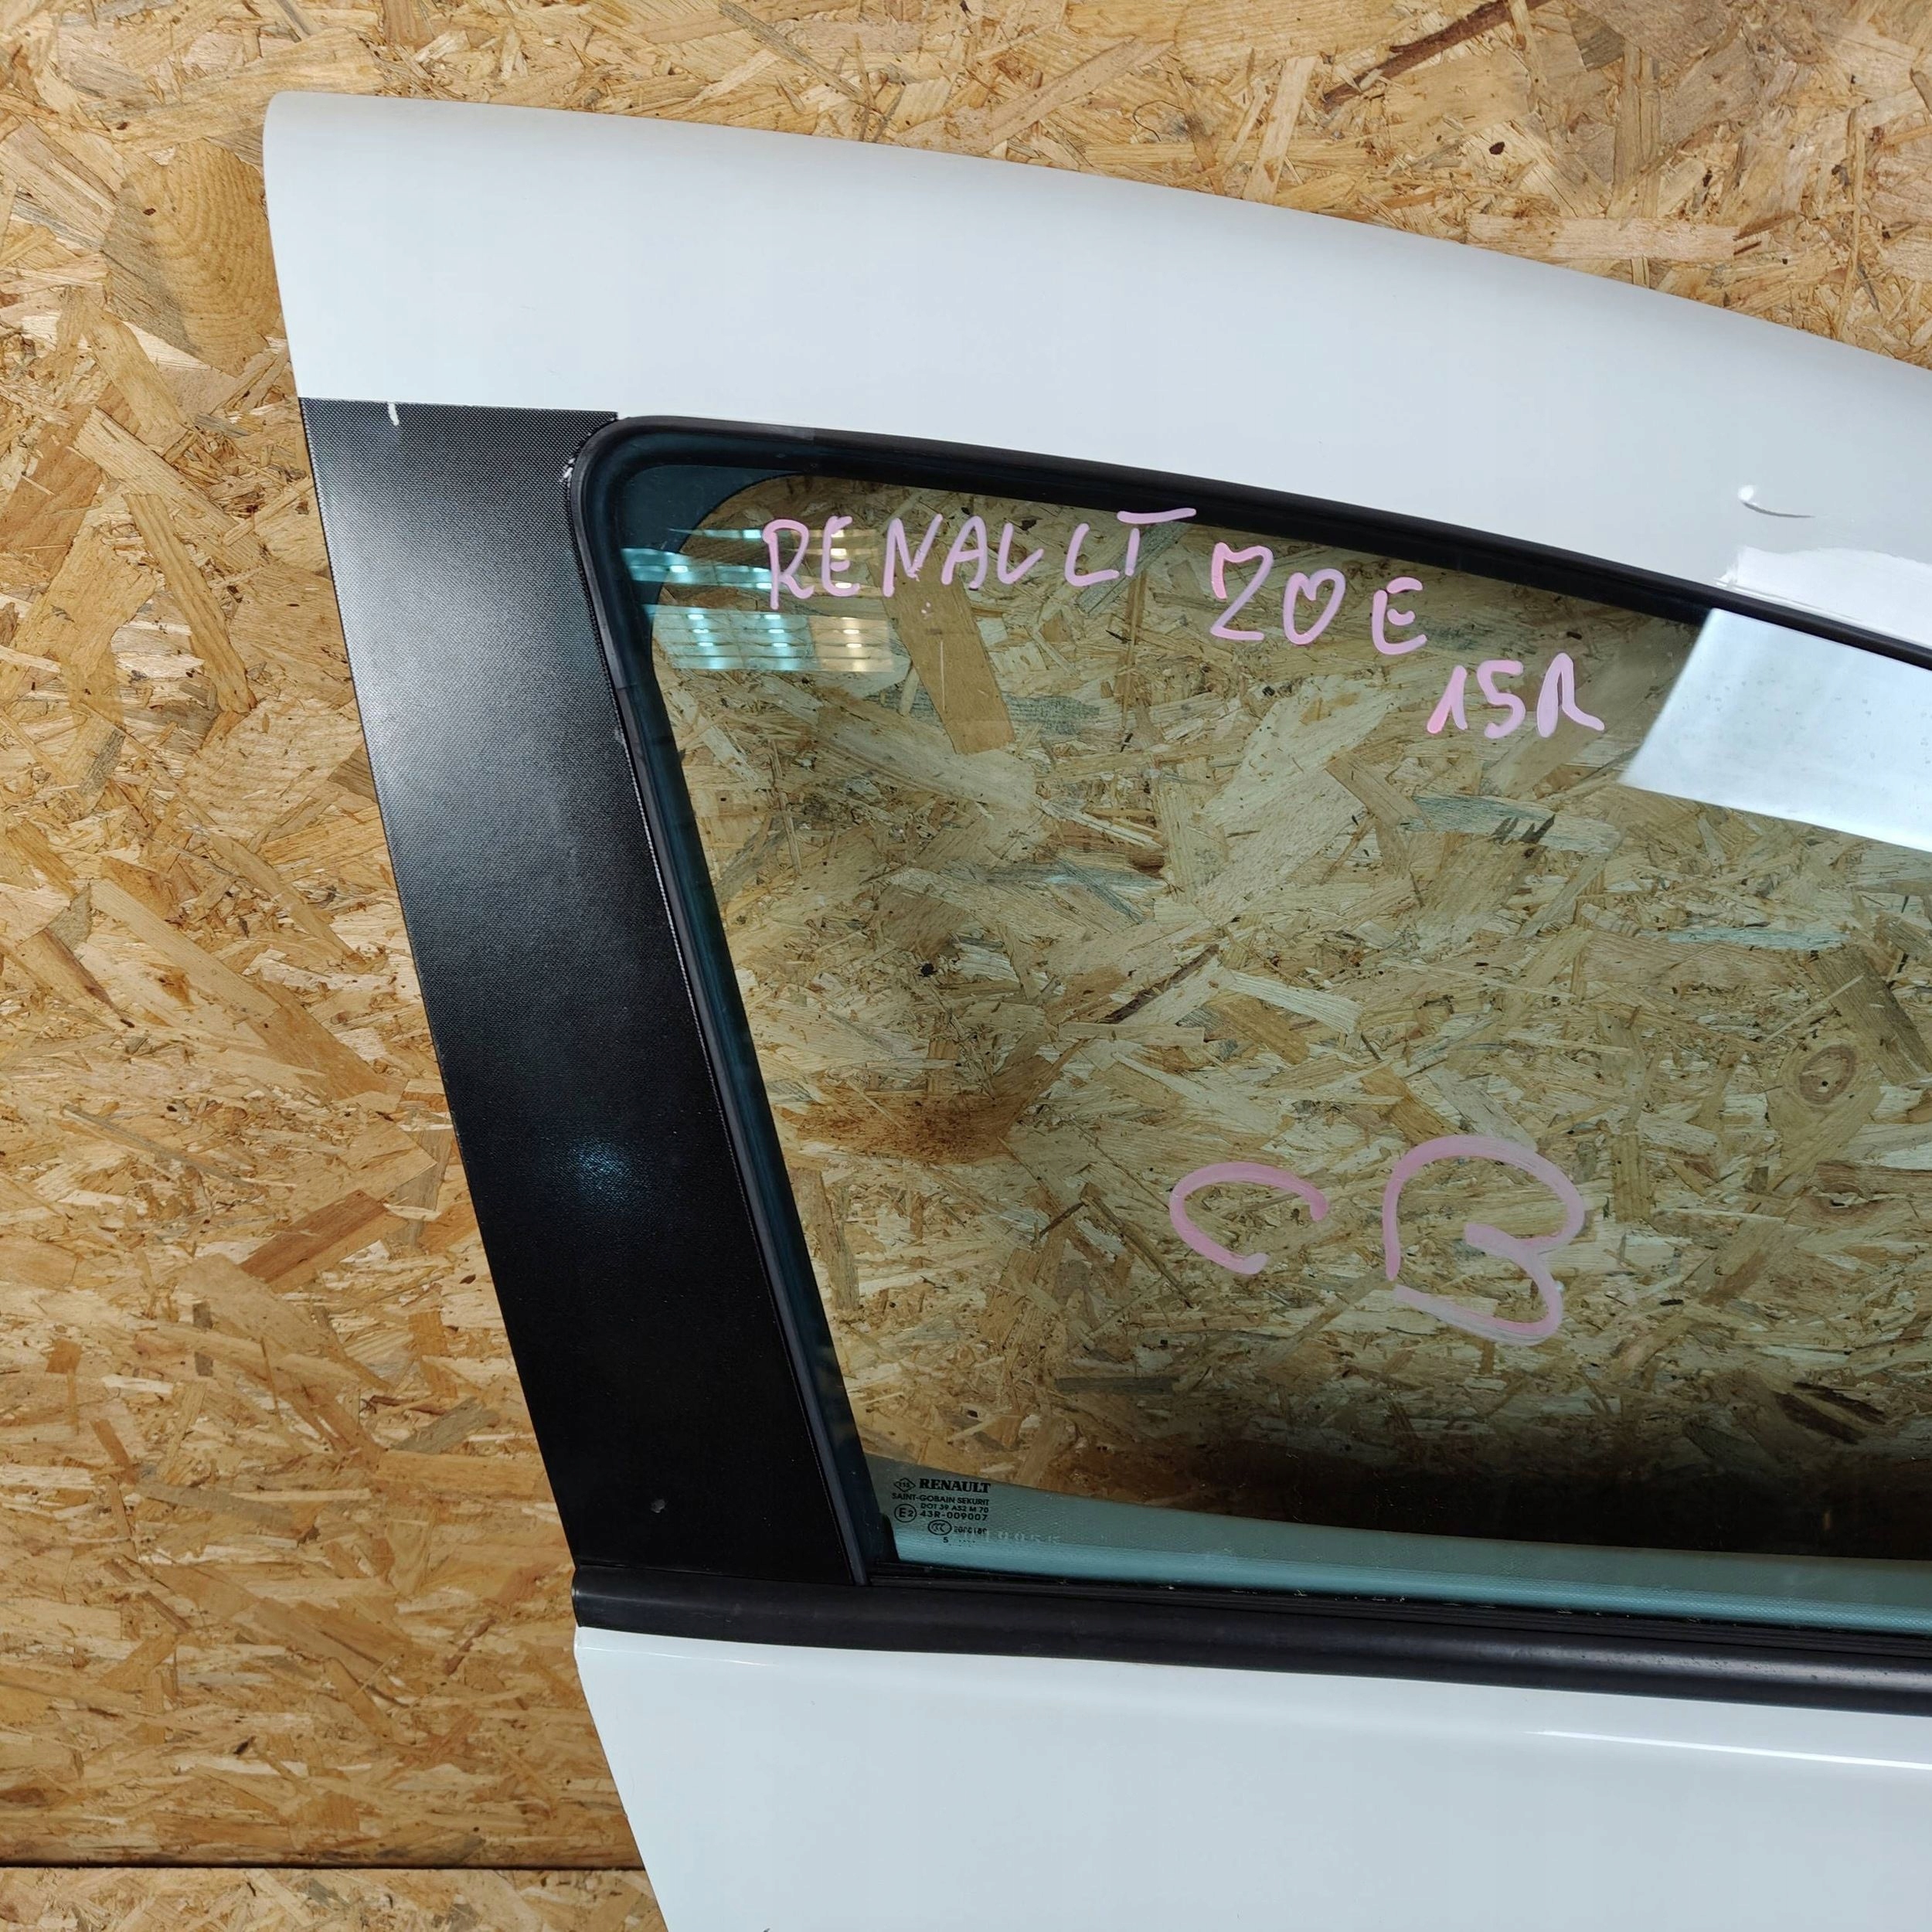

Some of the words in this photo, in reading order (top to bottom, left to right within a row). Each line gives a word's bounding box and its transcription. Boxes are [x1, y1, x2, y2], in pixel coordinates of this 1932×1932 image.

[762, 507, 1198, 611] RENAULT
[1209, 542, 1428, 655] ZOE
[919, 1478, 991, 1494] RENAULT
[891, 1492, 955, 1504] SAINT-GOBAIN
[957, 1497, 990, 1506] SEKURIT
[920, 1510, 988, 1521] 43R-009007
